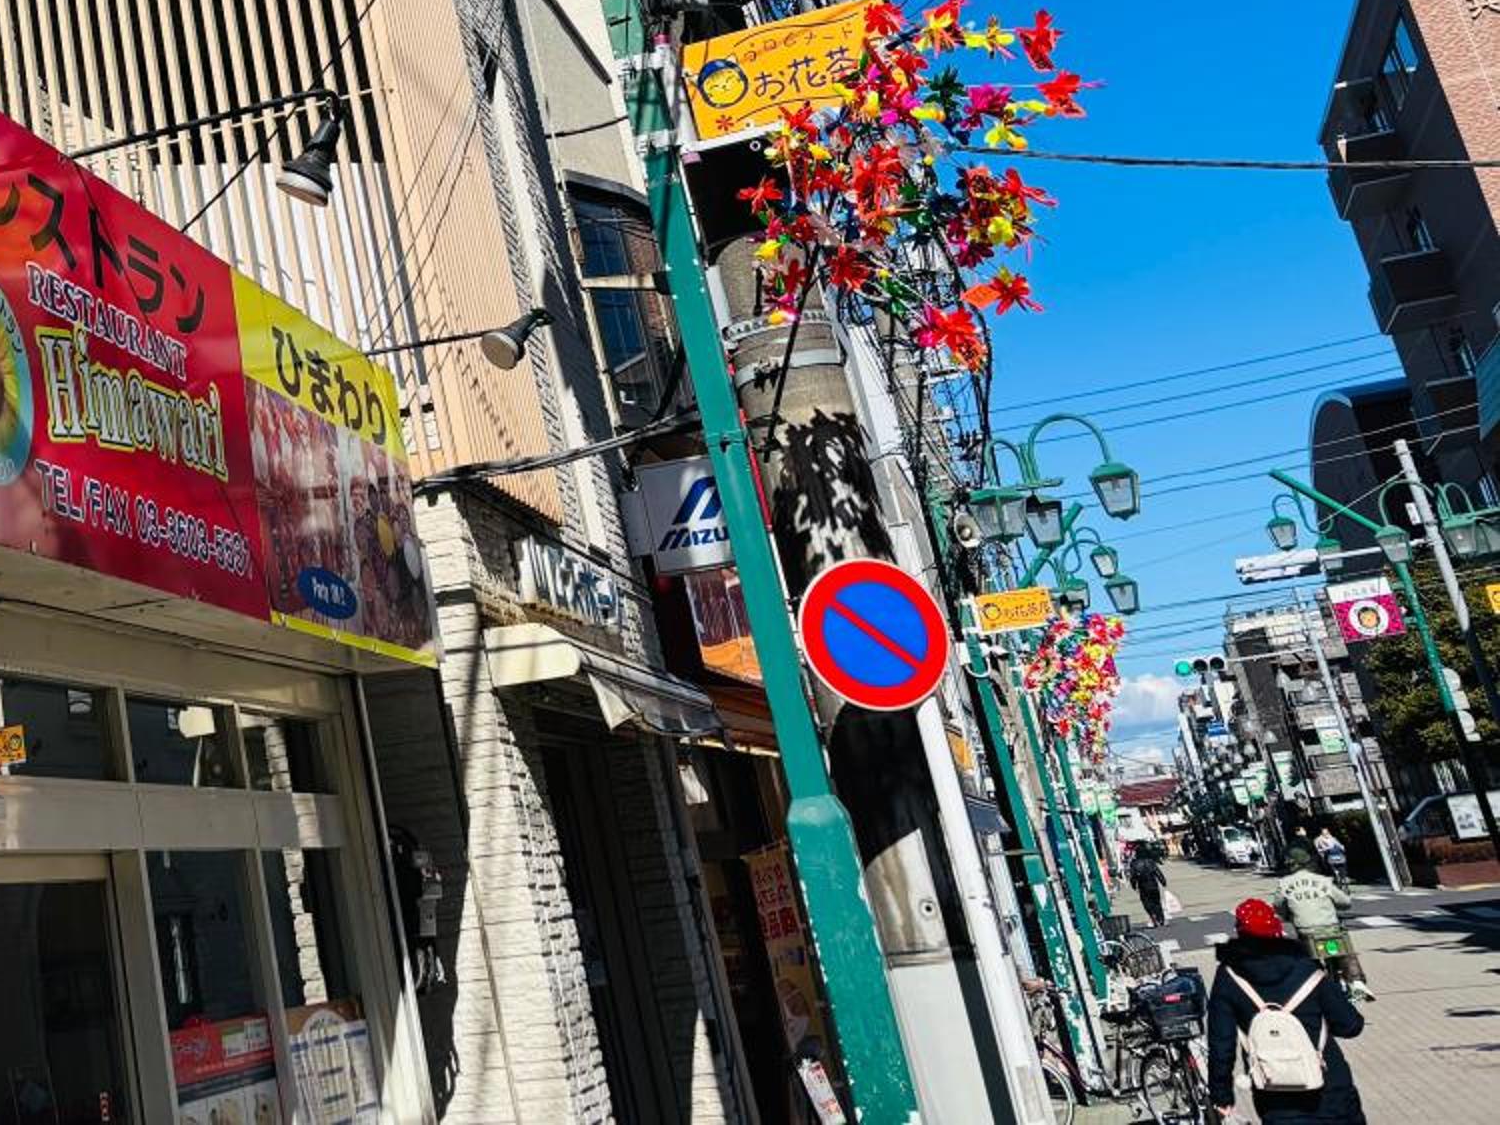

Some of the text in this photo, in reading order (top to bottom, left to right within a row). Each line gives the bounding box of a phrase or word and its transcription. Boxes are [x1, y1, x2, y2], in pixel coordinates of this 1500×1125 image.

[24, 260, 189, 382] RESTAURANT
[34, 323, 229, 482] Himawari
[271, 325, 387, 445] ひまわり
[34, 458, 133, 539] TEL/FAX
